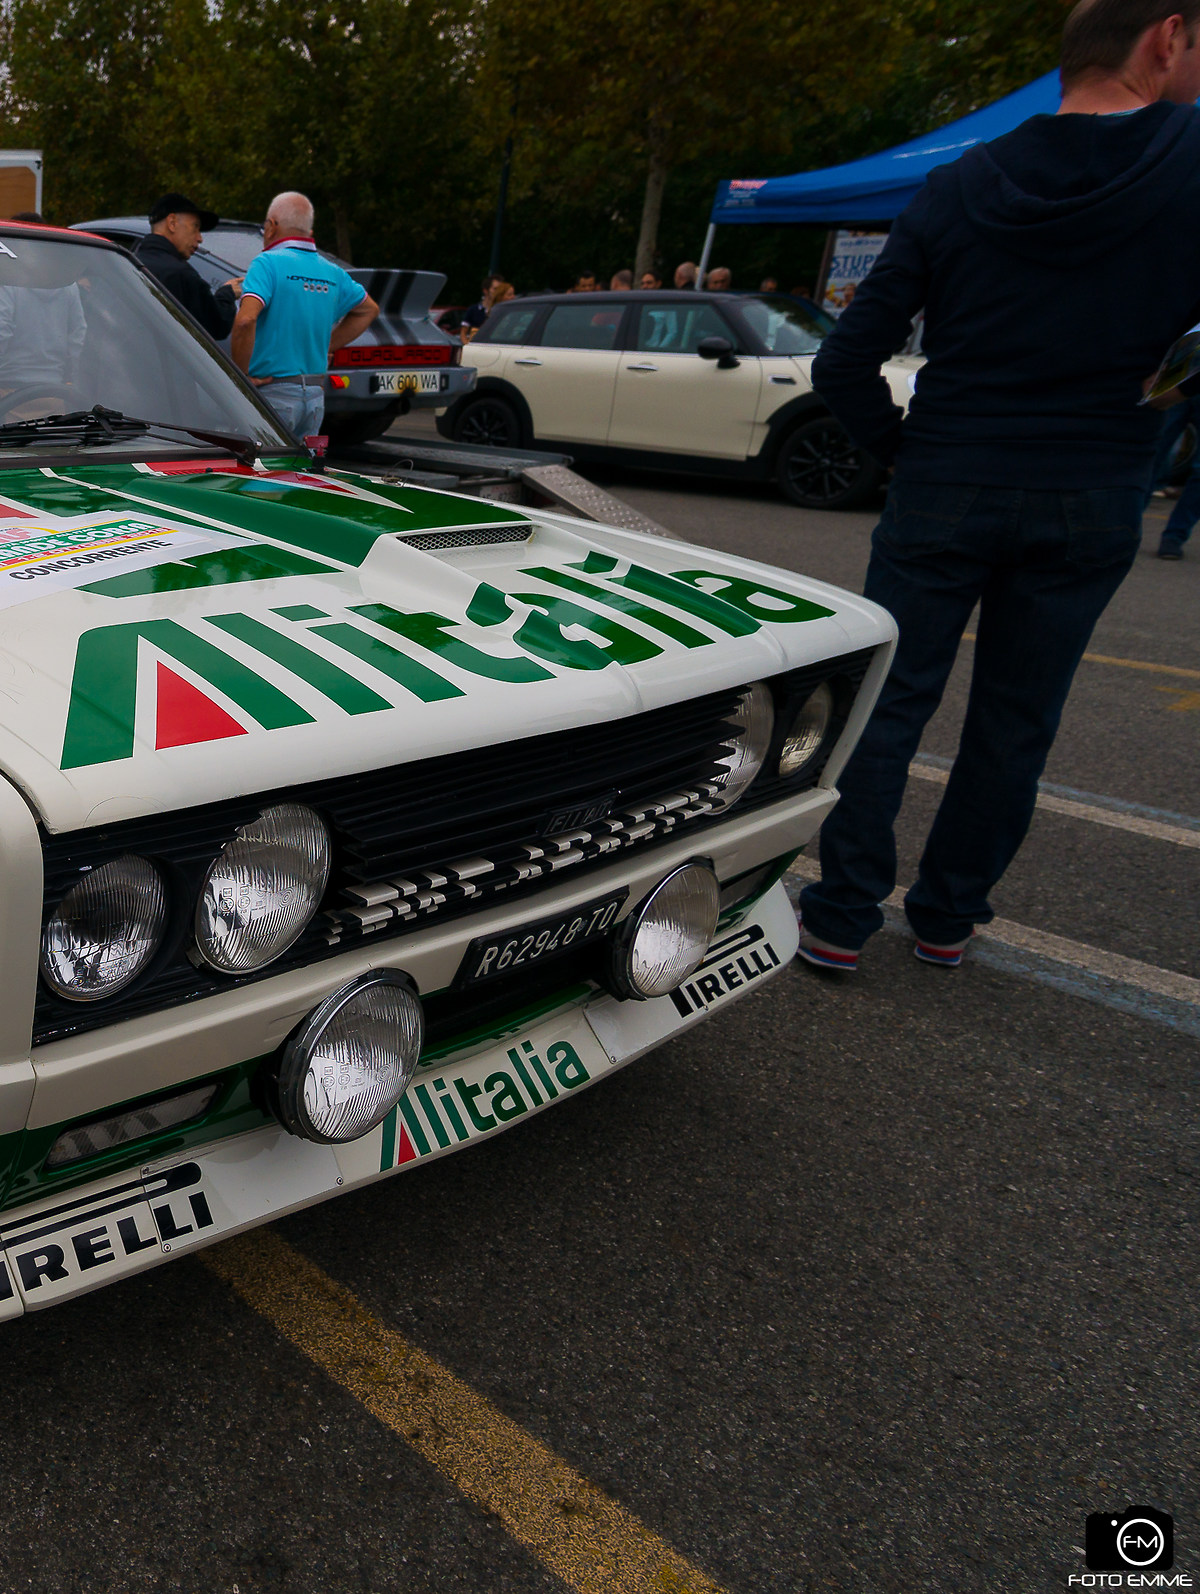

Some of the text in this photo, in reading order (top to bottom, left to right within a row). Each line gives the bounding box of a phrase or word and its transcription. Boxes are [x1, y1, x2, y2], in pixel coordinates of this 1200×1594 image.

[831, 254, 879, 270] STUP
[379, 374, 438, 391] AK 600 WA
[8, 539, 174, 580] CONCORRENTE
[68, 522, 155, 543] CORSA
[59, 550, 836, 770] Alitalia
[473, 901, 619, 979] R62948 TO
[667, 923, 781, 1019] PIRELLI
[379, 1039, 591, 1173] Alitalia
